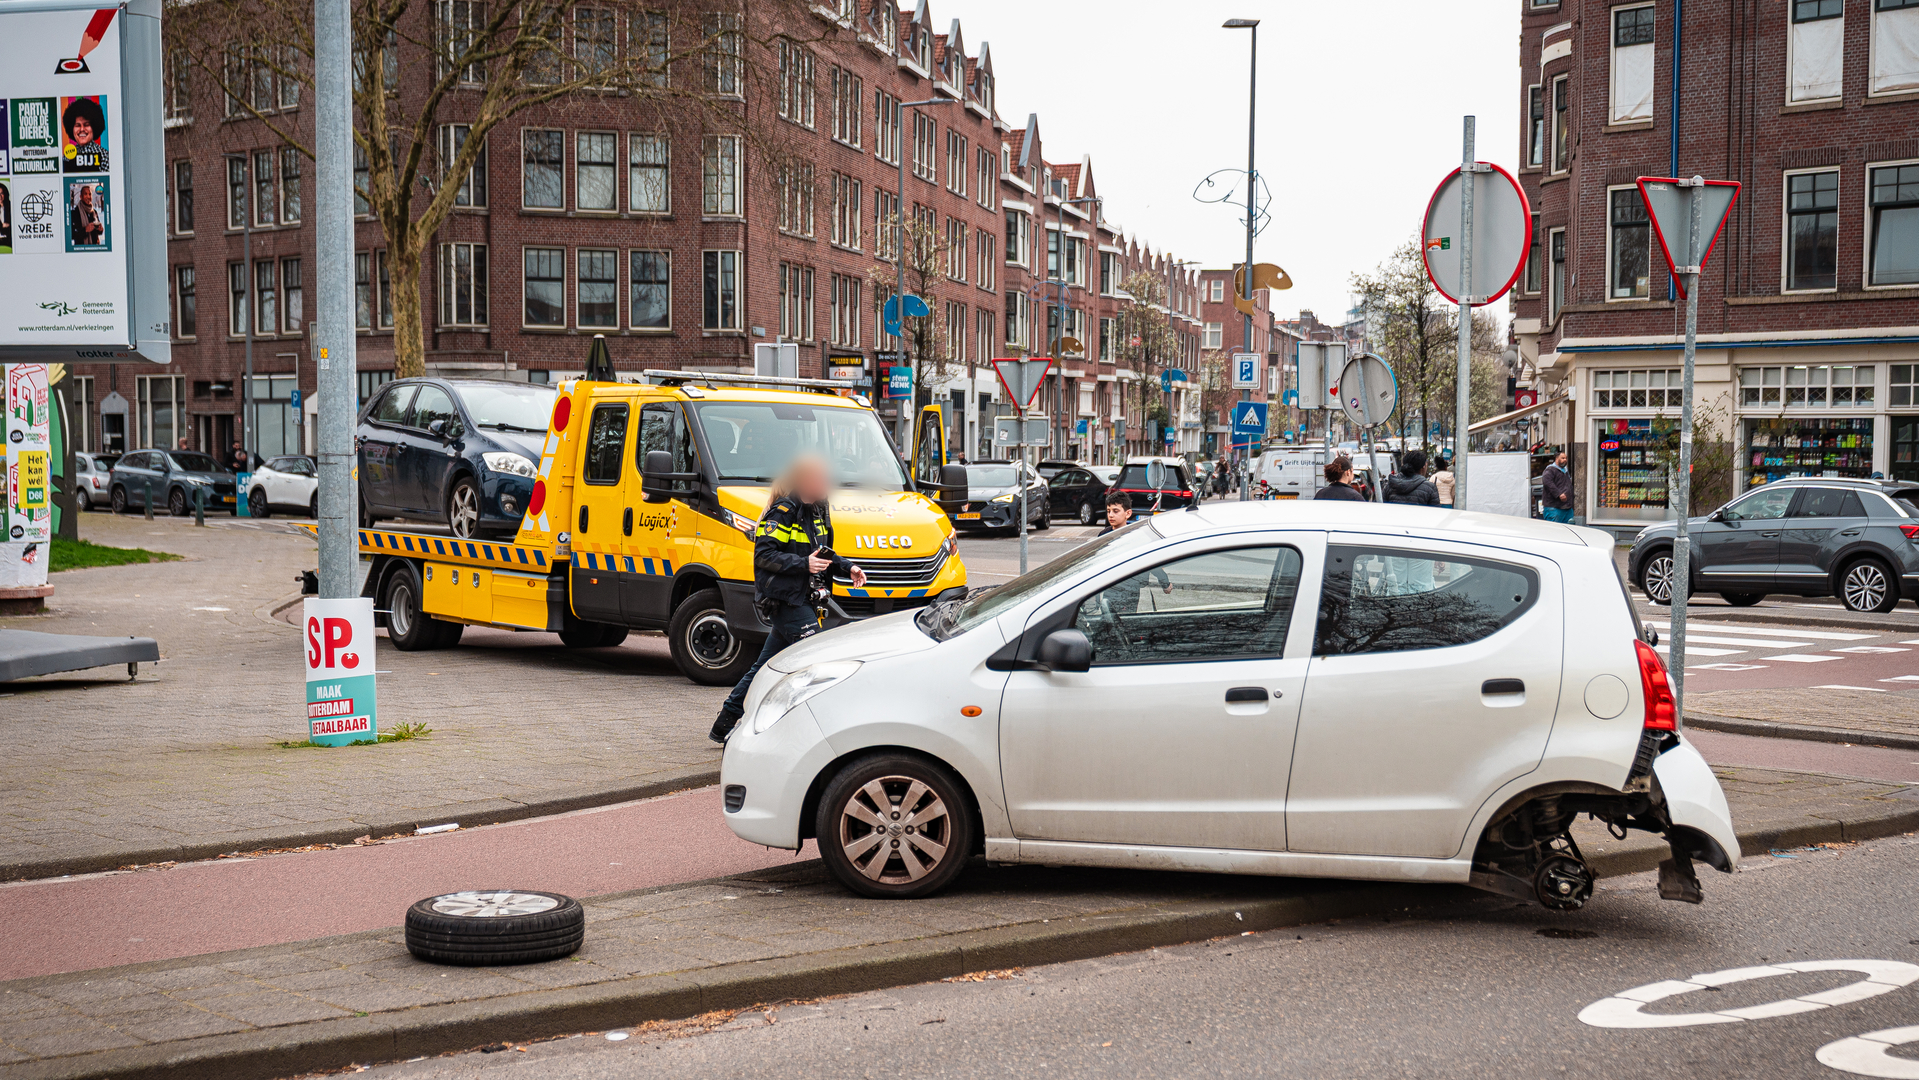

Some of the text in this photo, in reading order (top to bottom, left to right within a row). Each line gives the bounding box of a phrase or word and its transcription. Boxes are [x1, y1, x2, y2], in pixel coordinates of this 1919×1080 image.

[18, 102, 49, 116] PARTIJ
[19, 115, 49, 127] VOOR DE
[19, 126, 50, 139] DIEREN
[76, 154, 100, 166] BIJ1
[18, 223, 53, 233] VREDE
[18, 324, 114, 333] www.rotterdam.nl/verkiezingen
[834, 368, 847, 377] ria
[1242, 362, 1250, 374] P
[890, 381, 910, 389] DENK
[292, 392, 299, 406] P
[27, 455, 43, 465] Het
[27, 466, 43, 475] kan
[27, 476, 43, 485] wél
[28, 490, 43, 500] D66
[831, 503, 886, 513] Logicx
[638, 512, 671, 531] Logicx
[855, 535, 913, 549] IVECO
[316, 684, 343, 699] MAAK
